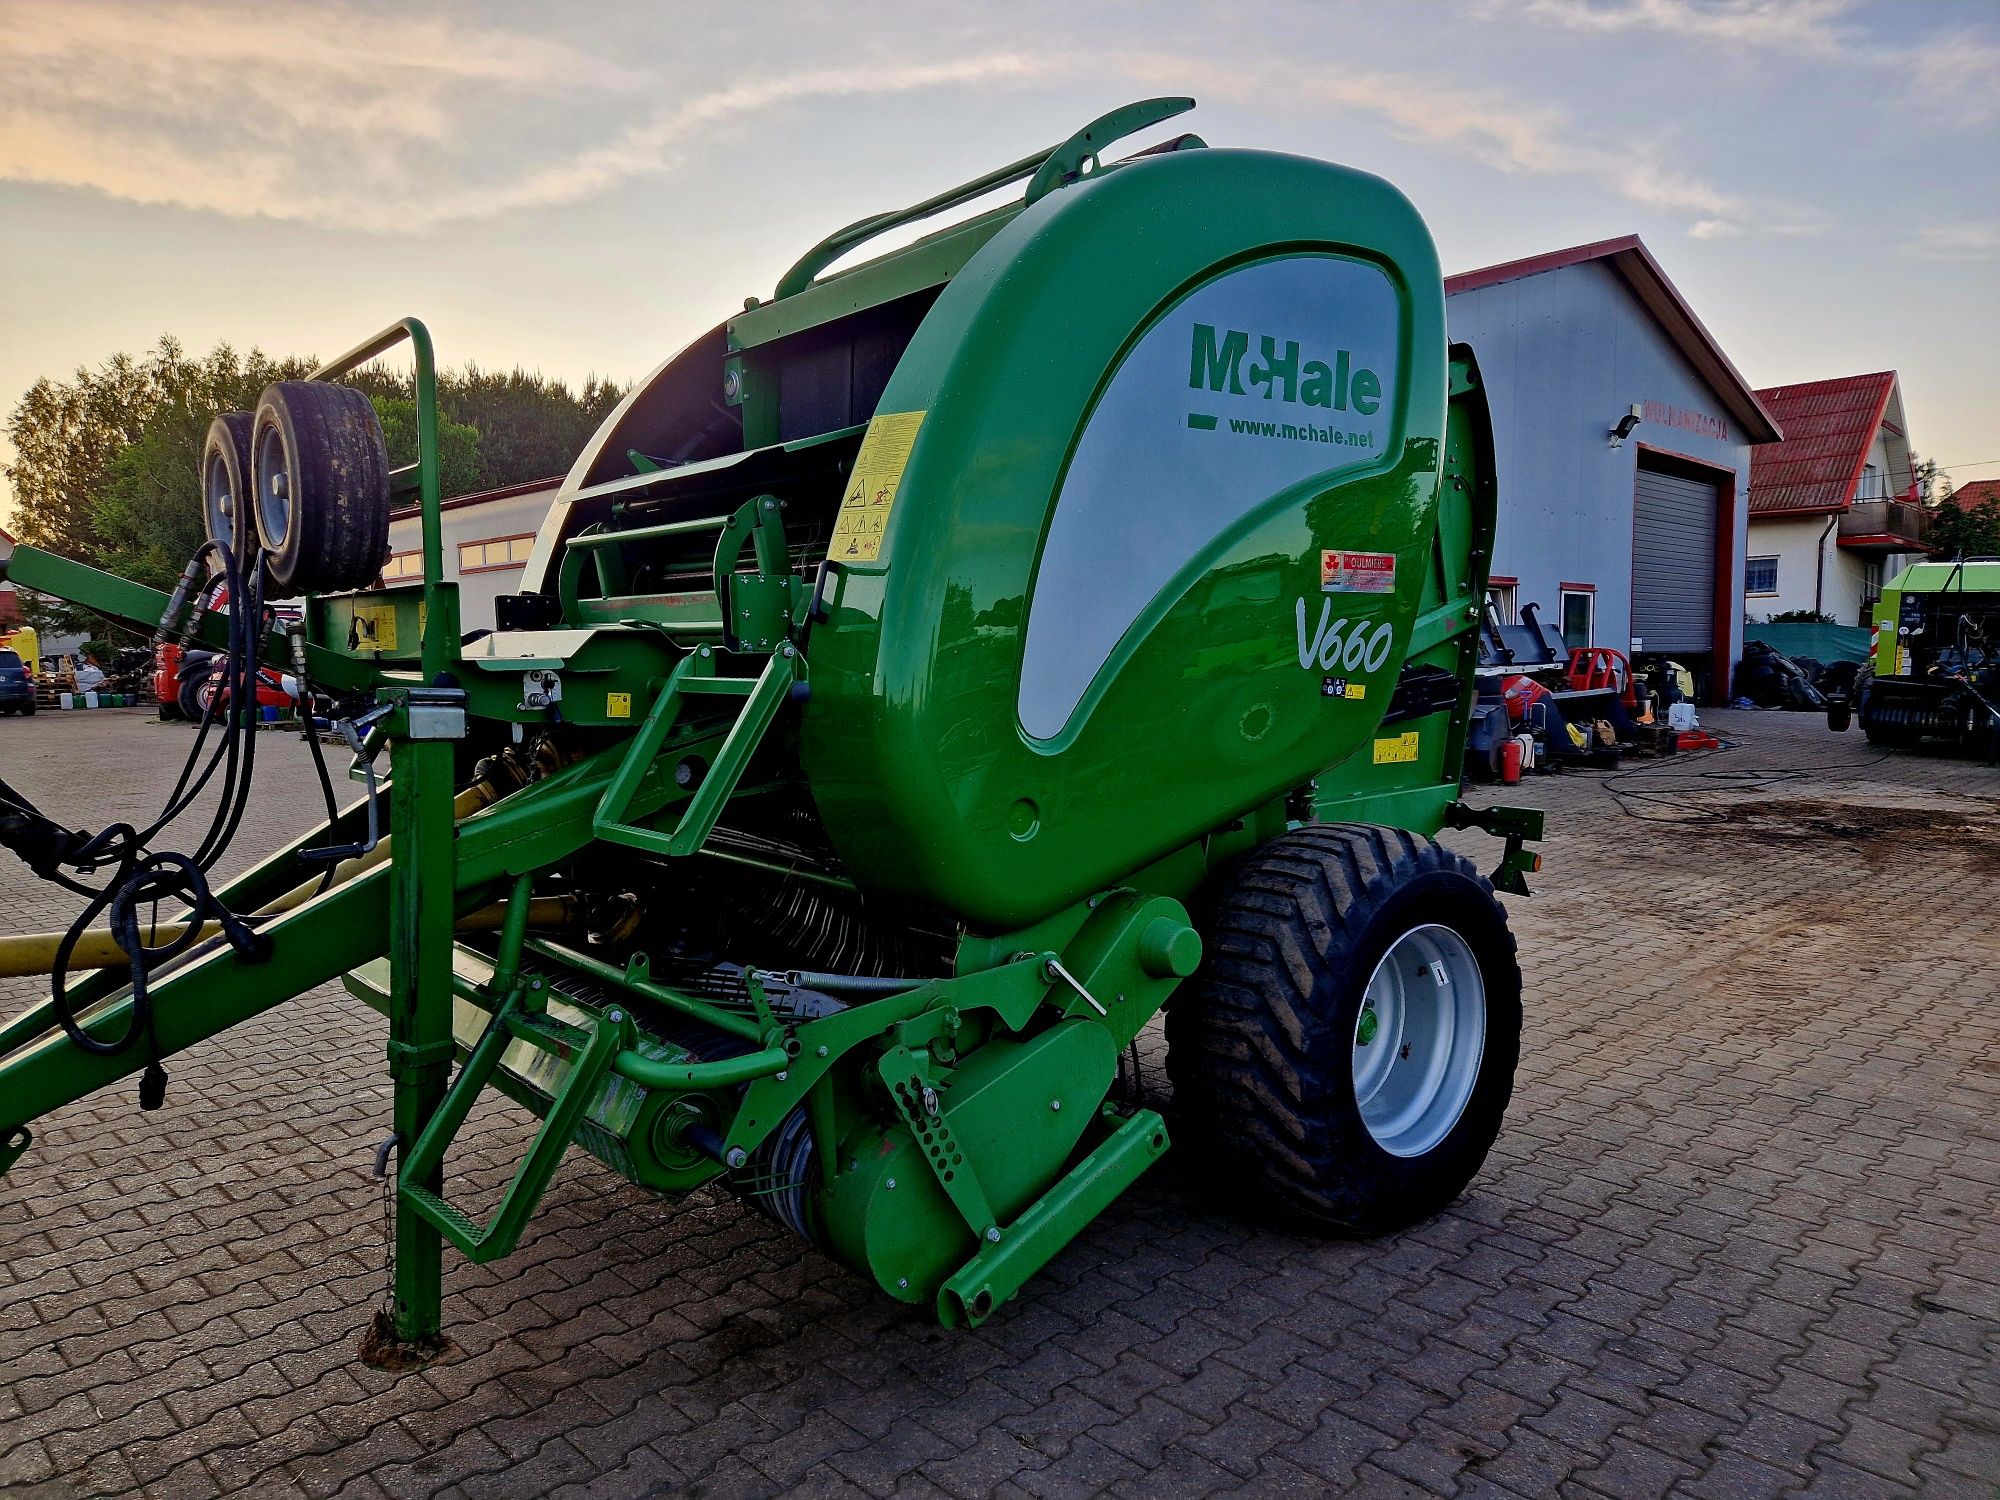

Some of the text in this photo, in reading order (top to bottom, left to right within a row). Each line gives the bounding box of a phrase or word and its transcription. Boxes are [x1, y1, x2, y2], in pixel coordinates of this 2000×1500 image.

[1188, 322, 1382, 416] McHale
[1229, 418, 1374, 448] www.mchale.net
[1295, 596, 1393, 673] V660
